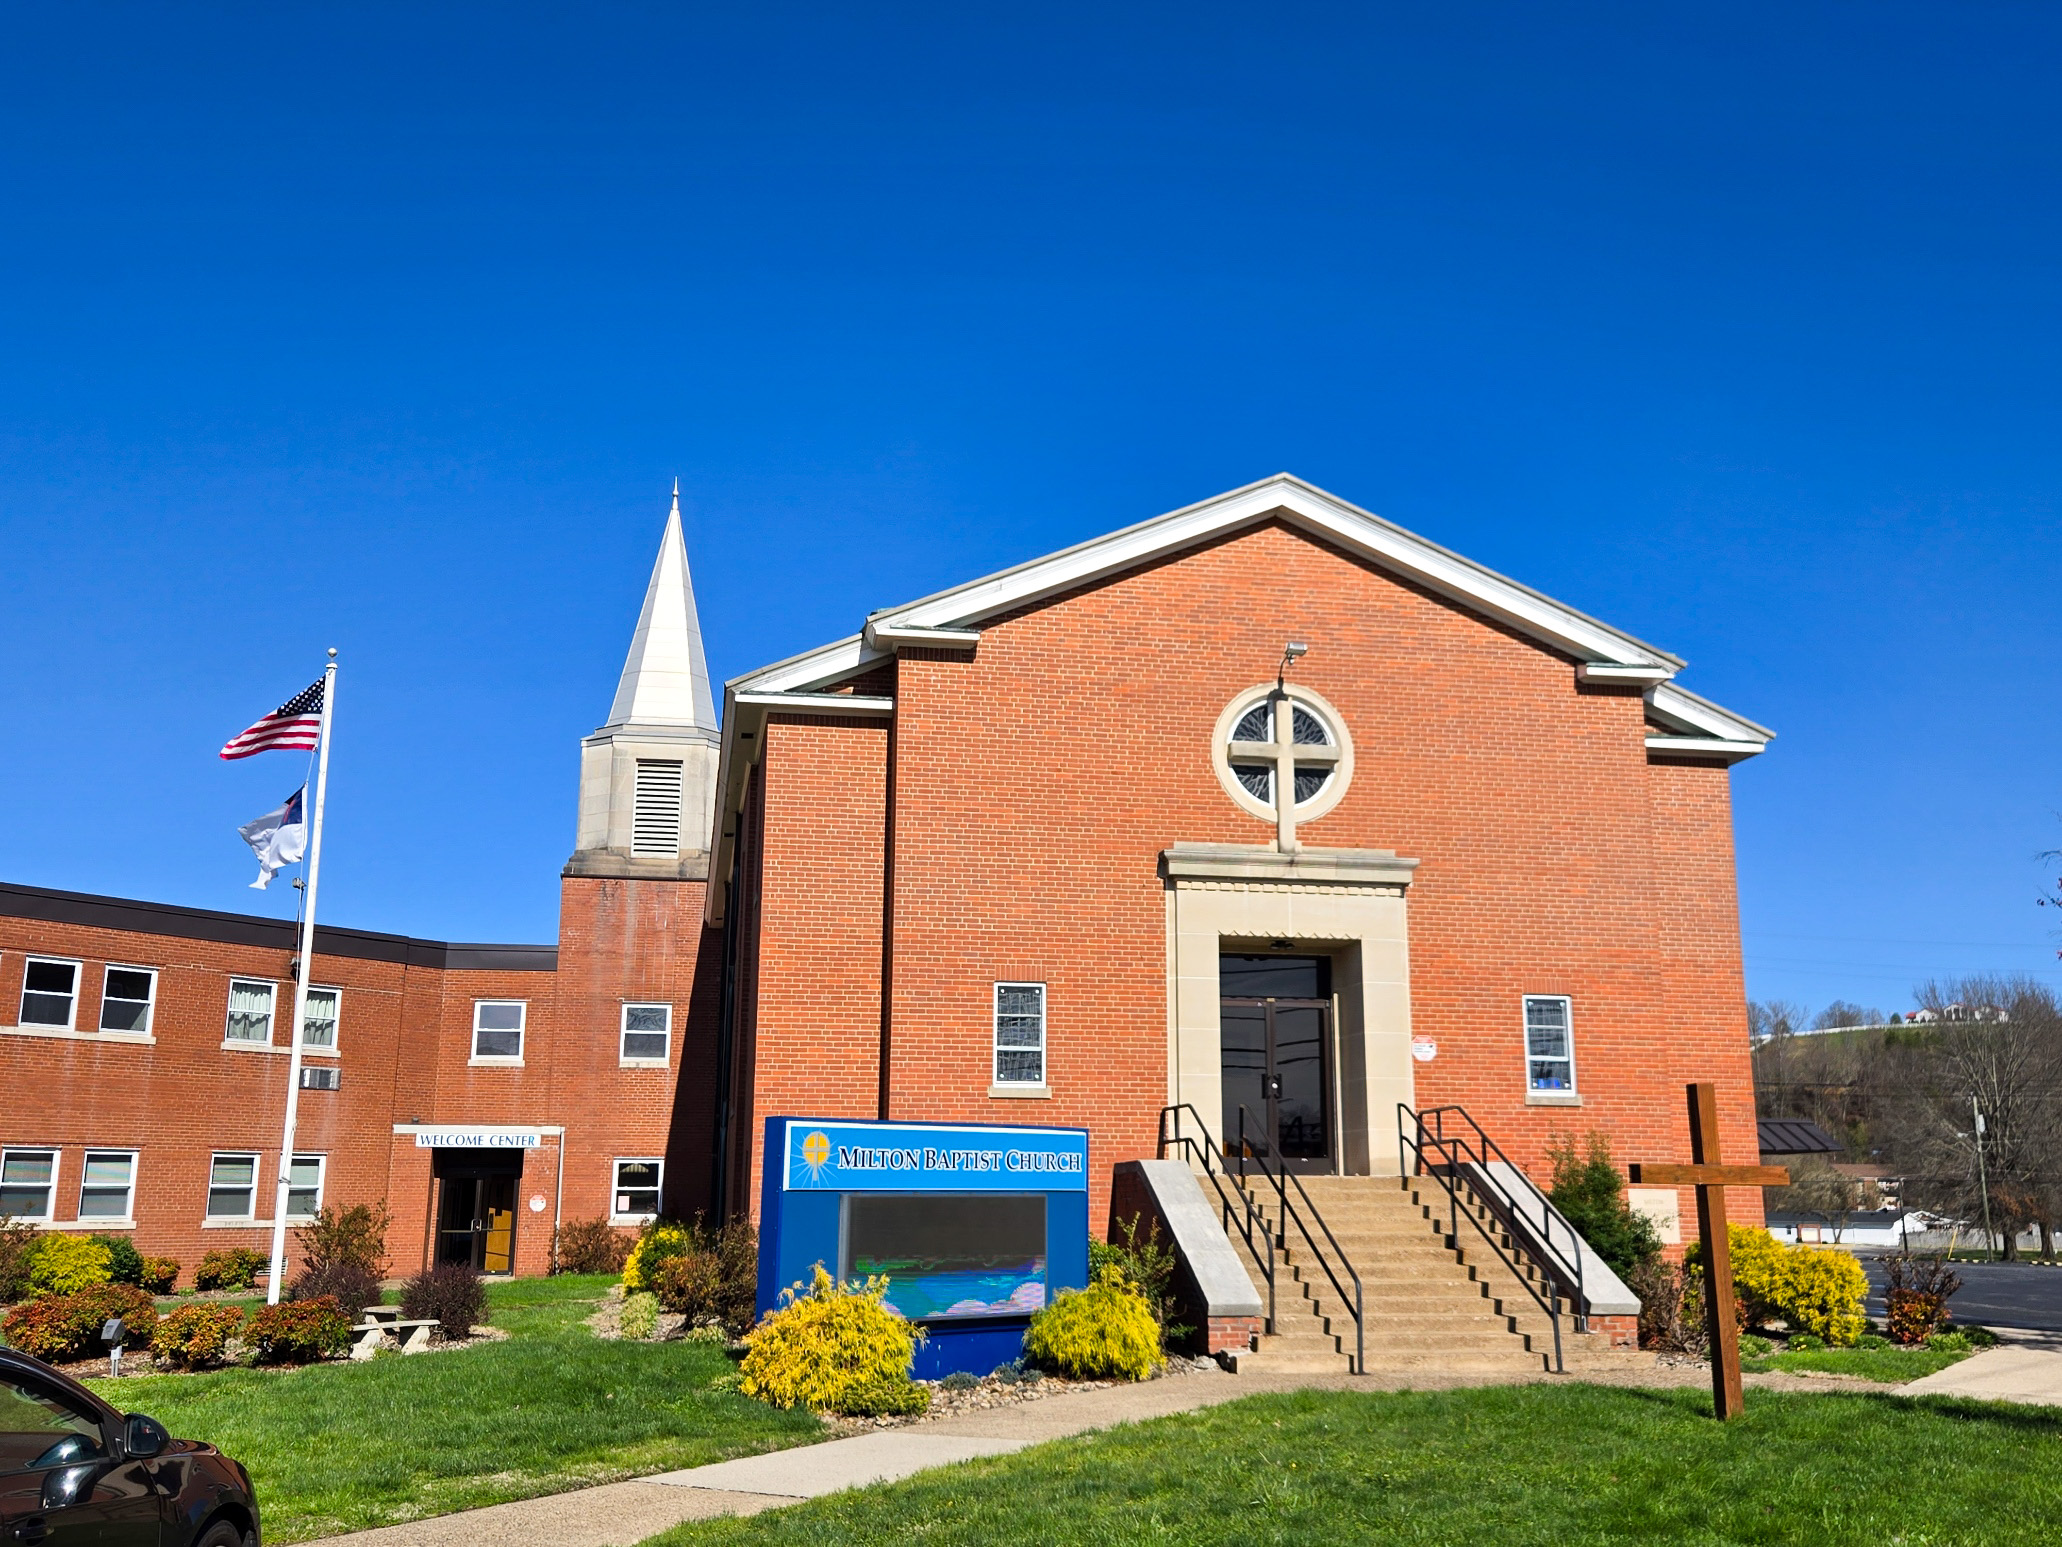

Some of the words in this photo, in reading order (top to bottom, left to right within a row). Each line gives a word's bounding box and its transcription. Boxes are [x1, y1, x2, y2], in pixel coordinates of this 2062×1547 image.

[420, 1134, 484, 1146] WELCOME
[489, 1135, 535, 1146] CENTER
[838, 1147, 920, 1170] MILTON
[924, 1149, 1002, 1170] BAPTIST
[1005, 1150, 1081, 1171] CHURCH
